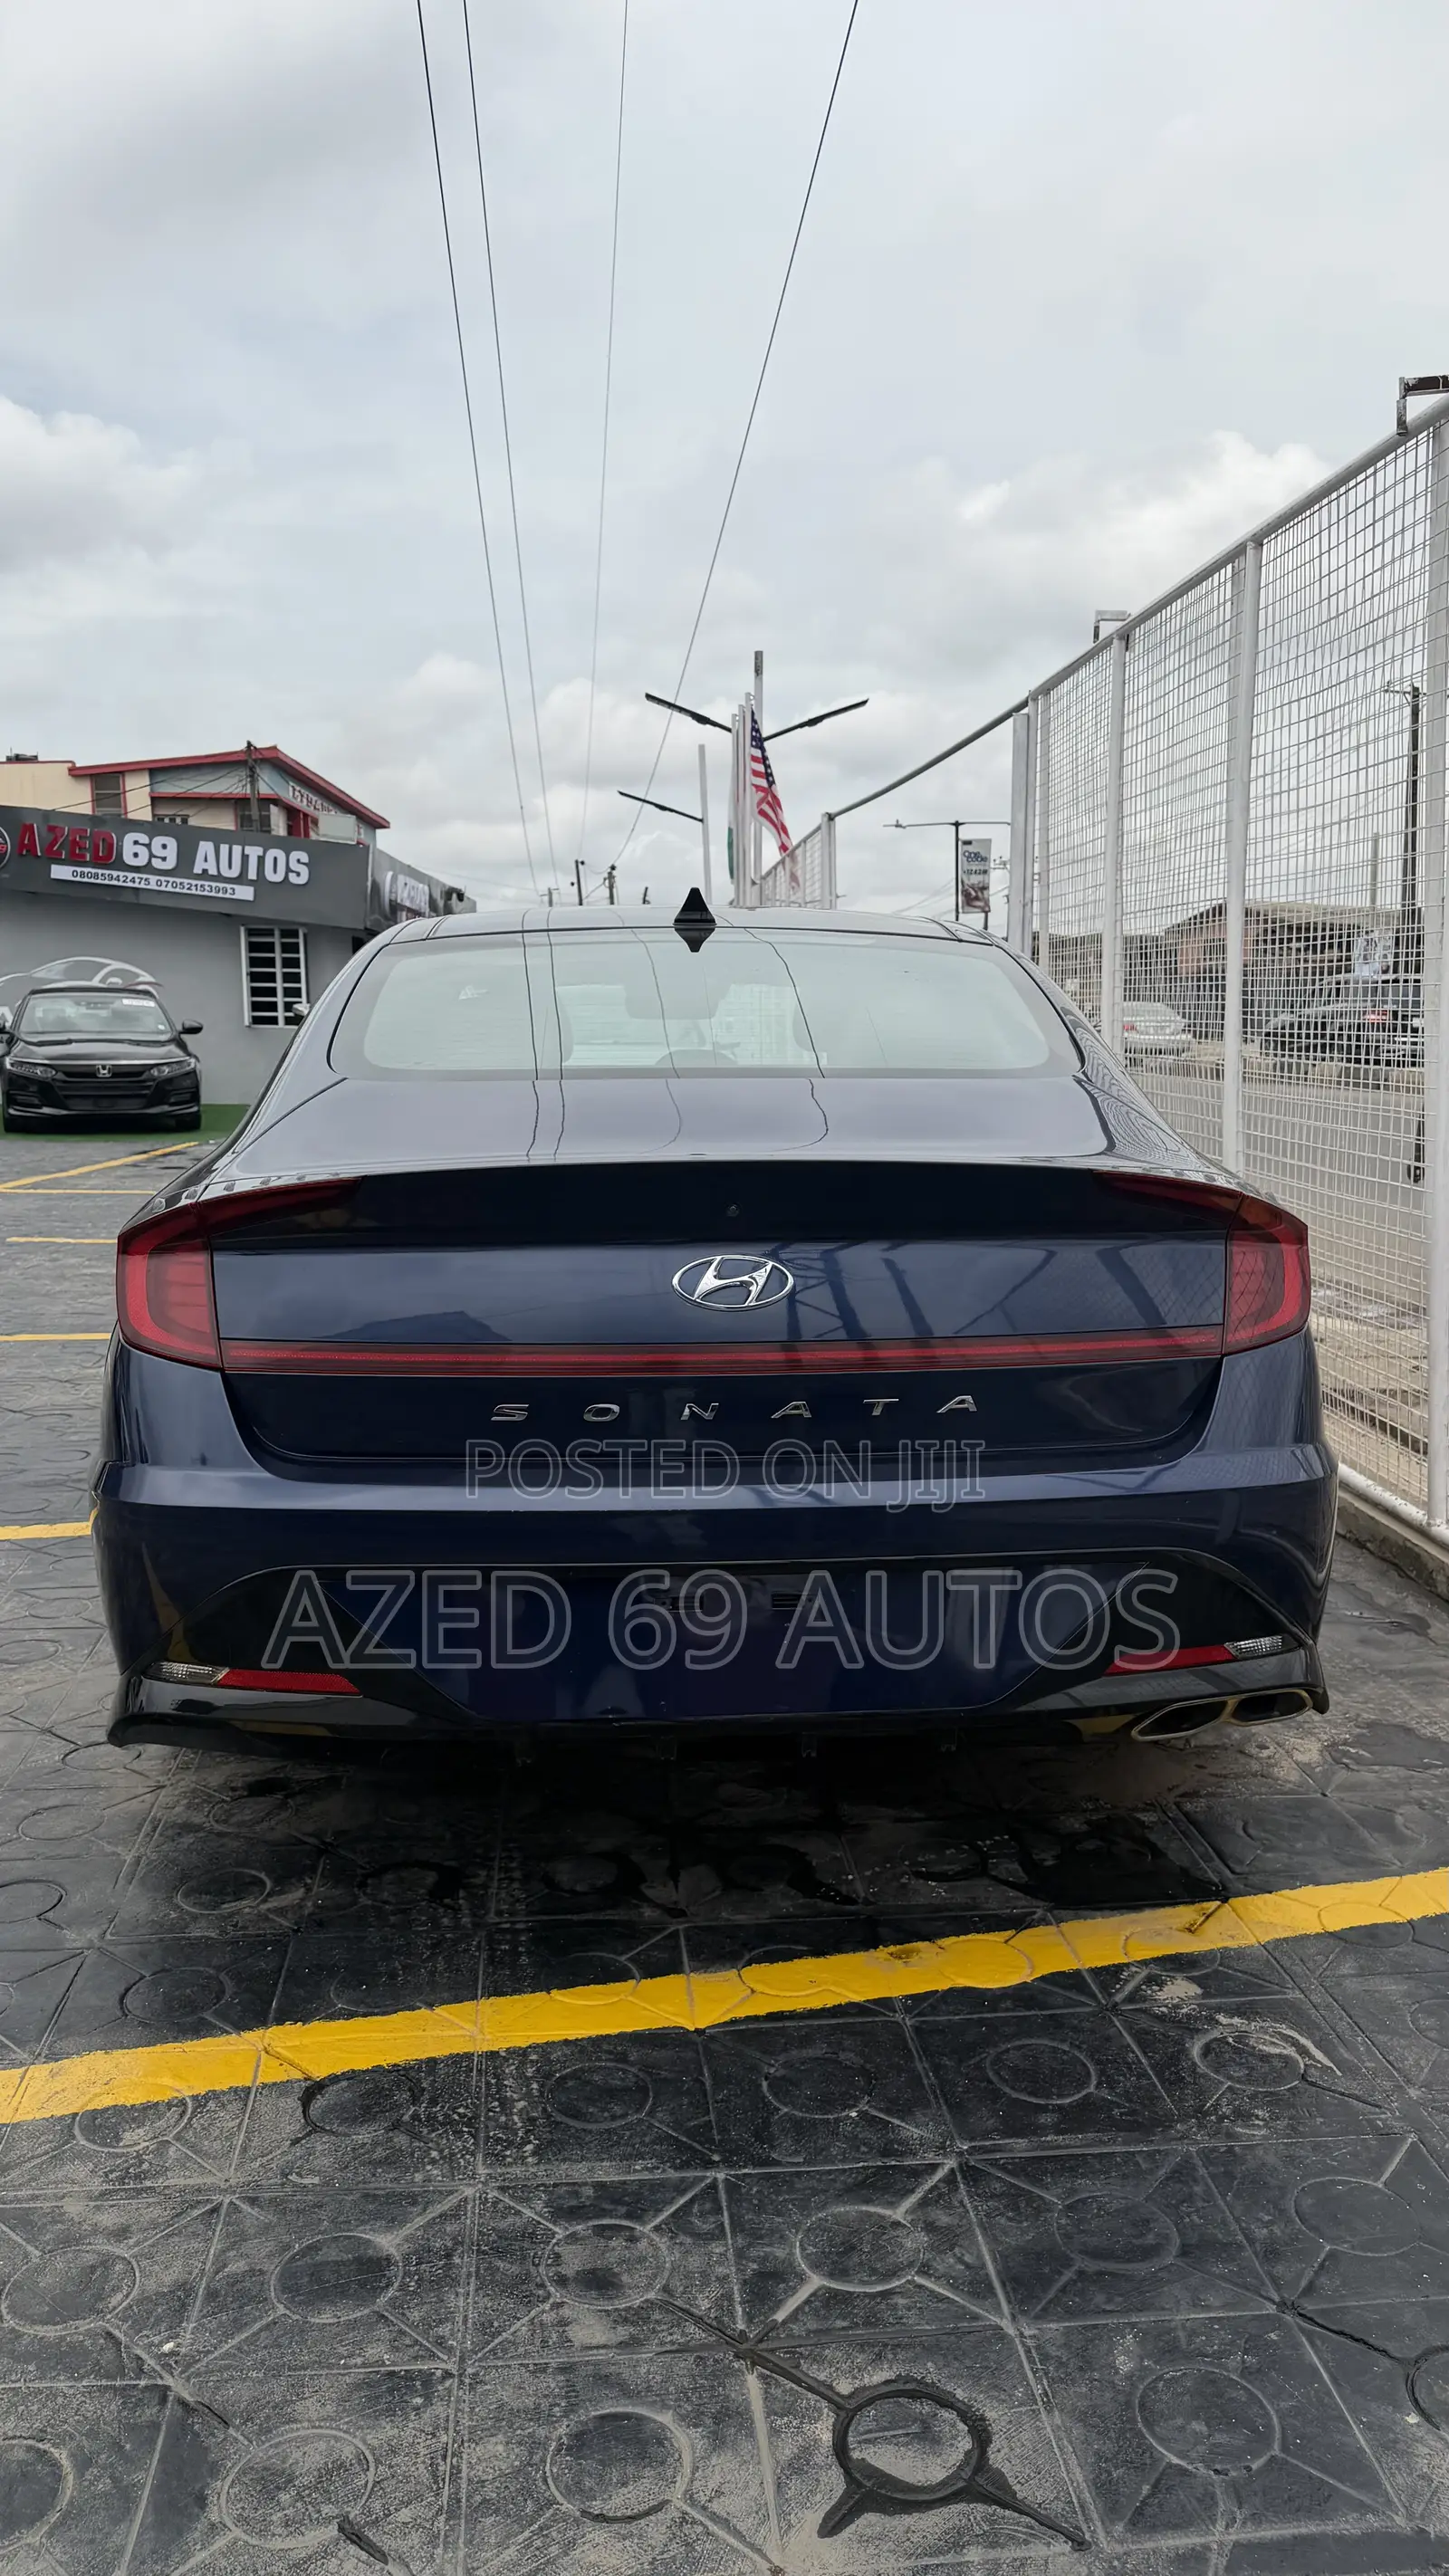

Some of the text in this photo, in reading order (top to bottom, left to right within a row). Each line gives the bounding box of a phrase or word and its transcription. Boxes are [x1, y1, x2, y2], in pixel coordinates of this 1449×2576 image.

[15, 821, 311, 886] AZED 69 AUTOS
[71, 868, 236, 896] 08085942475 07052153993
[491, 1393, 979, 1422] SONATA
